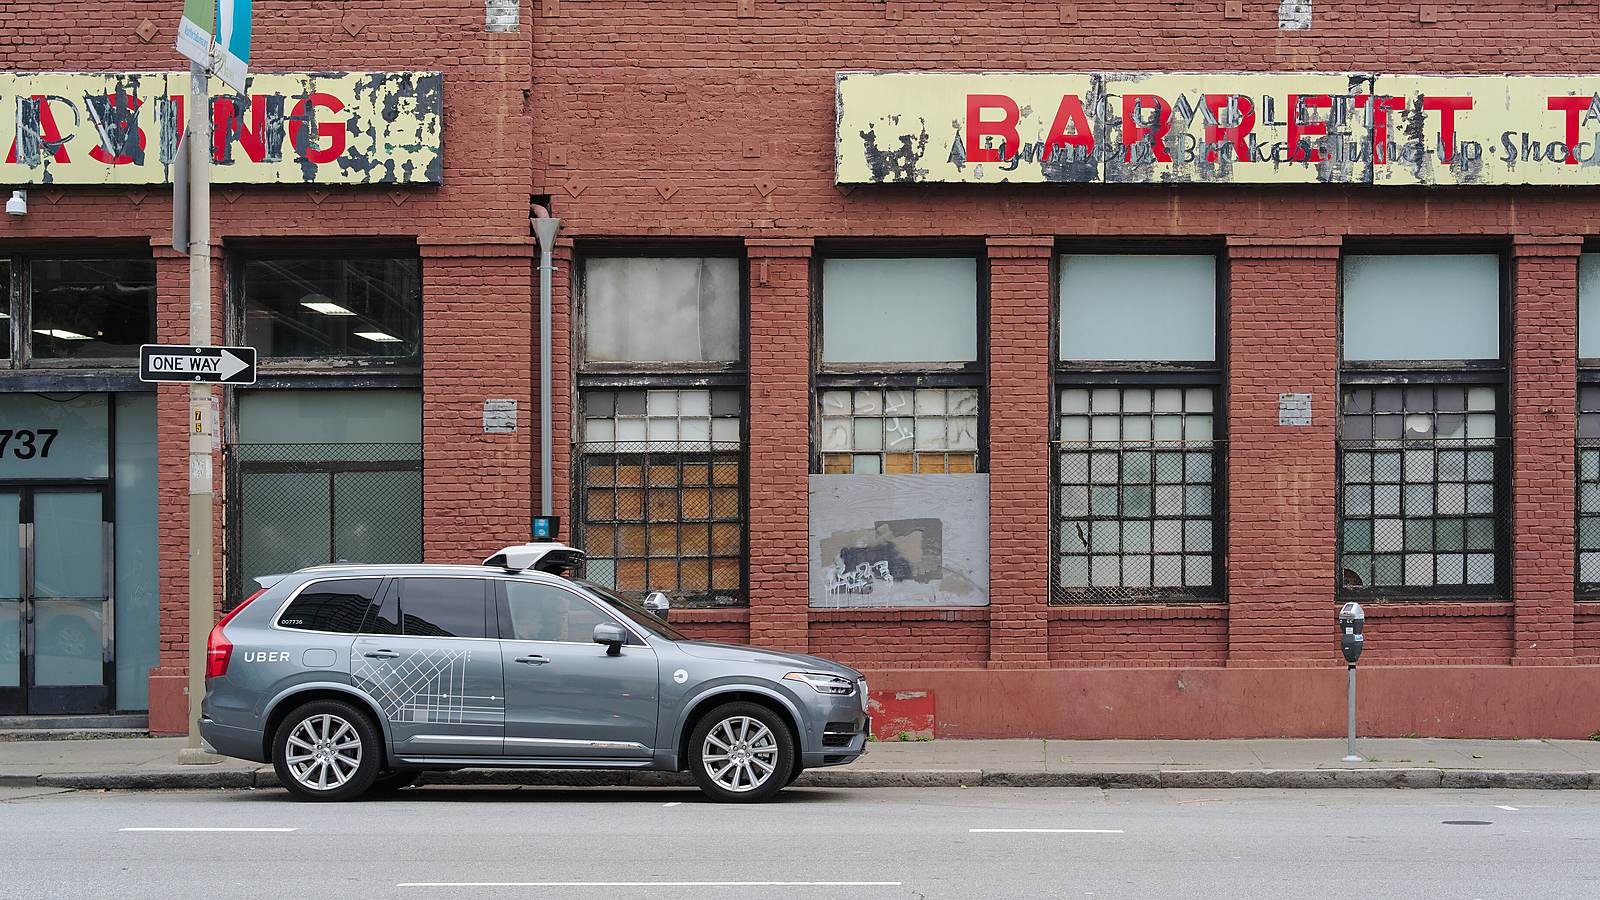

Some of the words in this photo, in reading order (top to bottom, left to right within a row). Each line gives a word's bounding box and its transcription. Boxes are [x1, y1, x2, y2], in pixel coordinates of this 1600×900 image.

[966, 94, 1473, 165] BARRETT
[153, 357, 183, 371] ONE
[190, 357, 220, 372] WAY
[0, 429, 58, 459] 737
[244, 652, 289, 662] UBER
